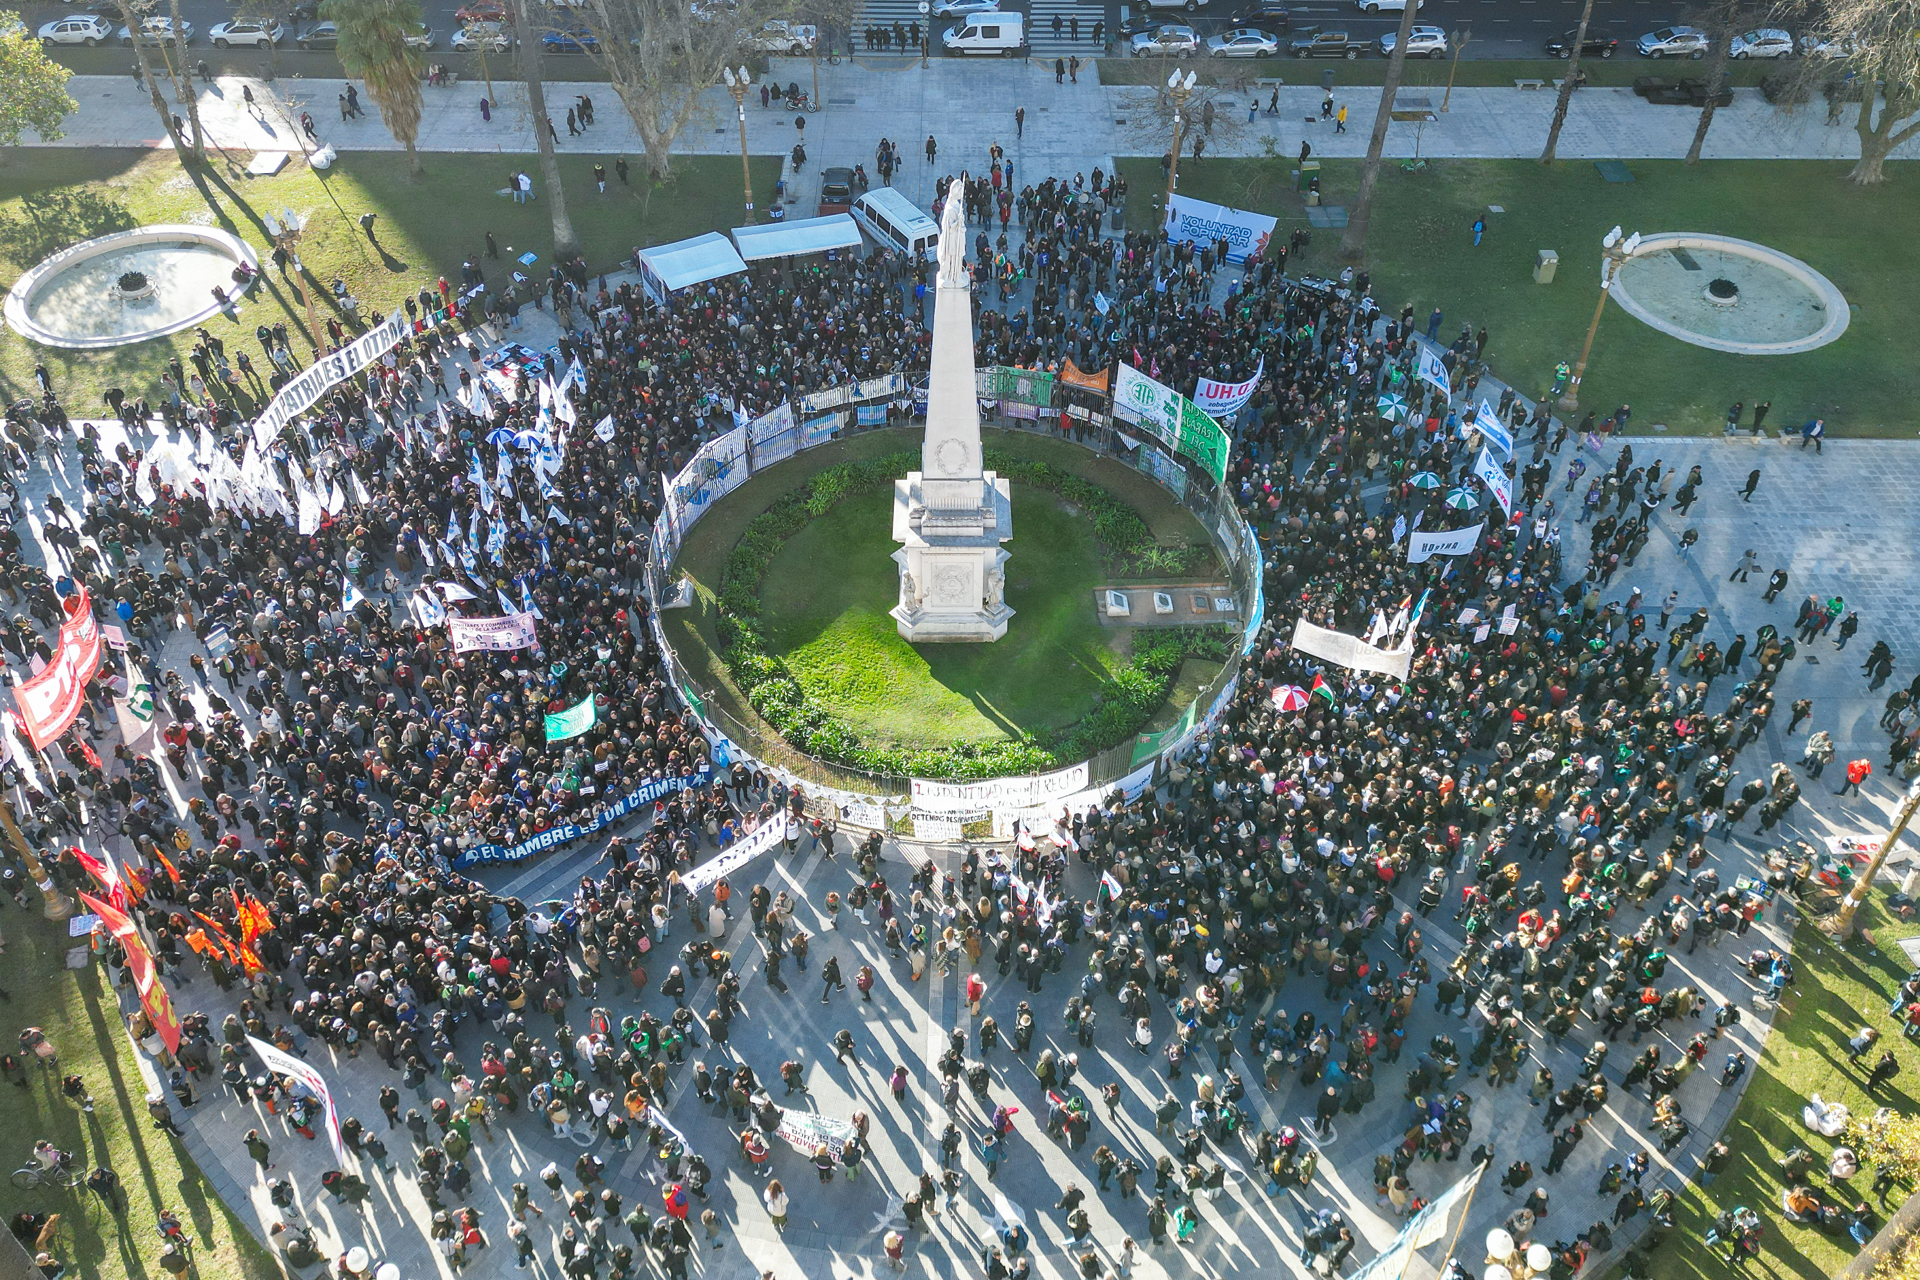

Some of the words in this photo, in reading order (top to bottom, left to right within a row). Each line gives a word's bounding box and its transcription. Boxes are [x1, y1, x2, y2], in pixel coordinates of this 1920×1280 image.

[1181, 222, 1250, 248] POPULAR
[1182, 214, 1252, 238] VOLUNTAD
[281, 367, 325, 415] PATRIA
[324, 356, 345, 386] ES
[345, 346, 363, 372] EL
[362, 321, 398, 360] OTRO
[480, 846, 499, 859] EL
[503, 826, 574, 860] HAMBRE
[580, 819, 600, 834] ES
[604, 806, 625, 822] UN
[628, 778, 687, 808] CRIMEN
